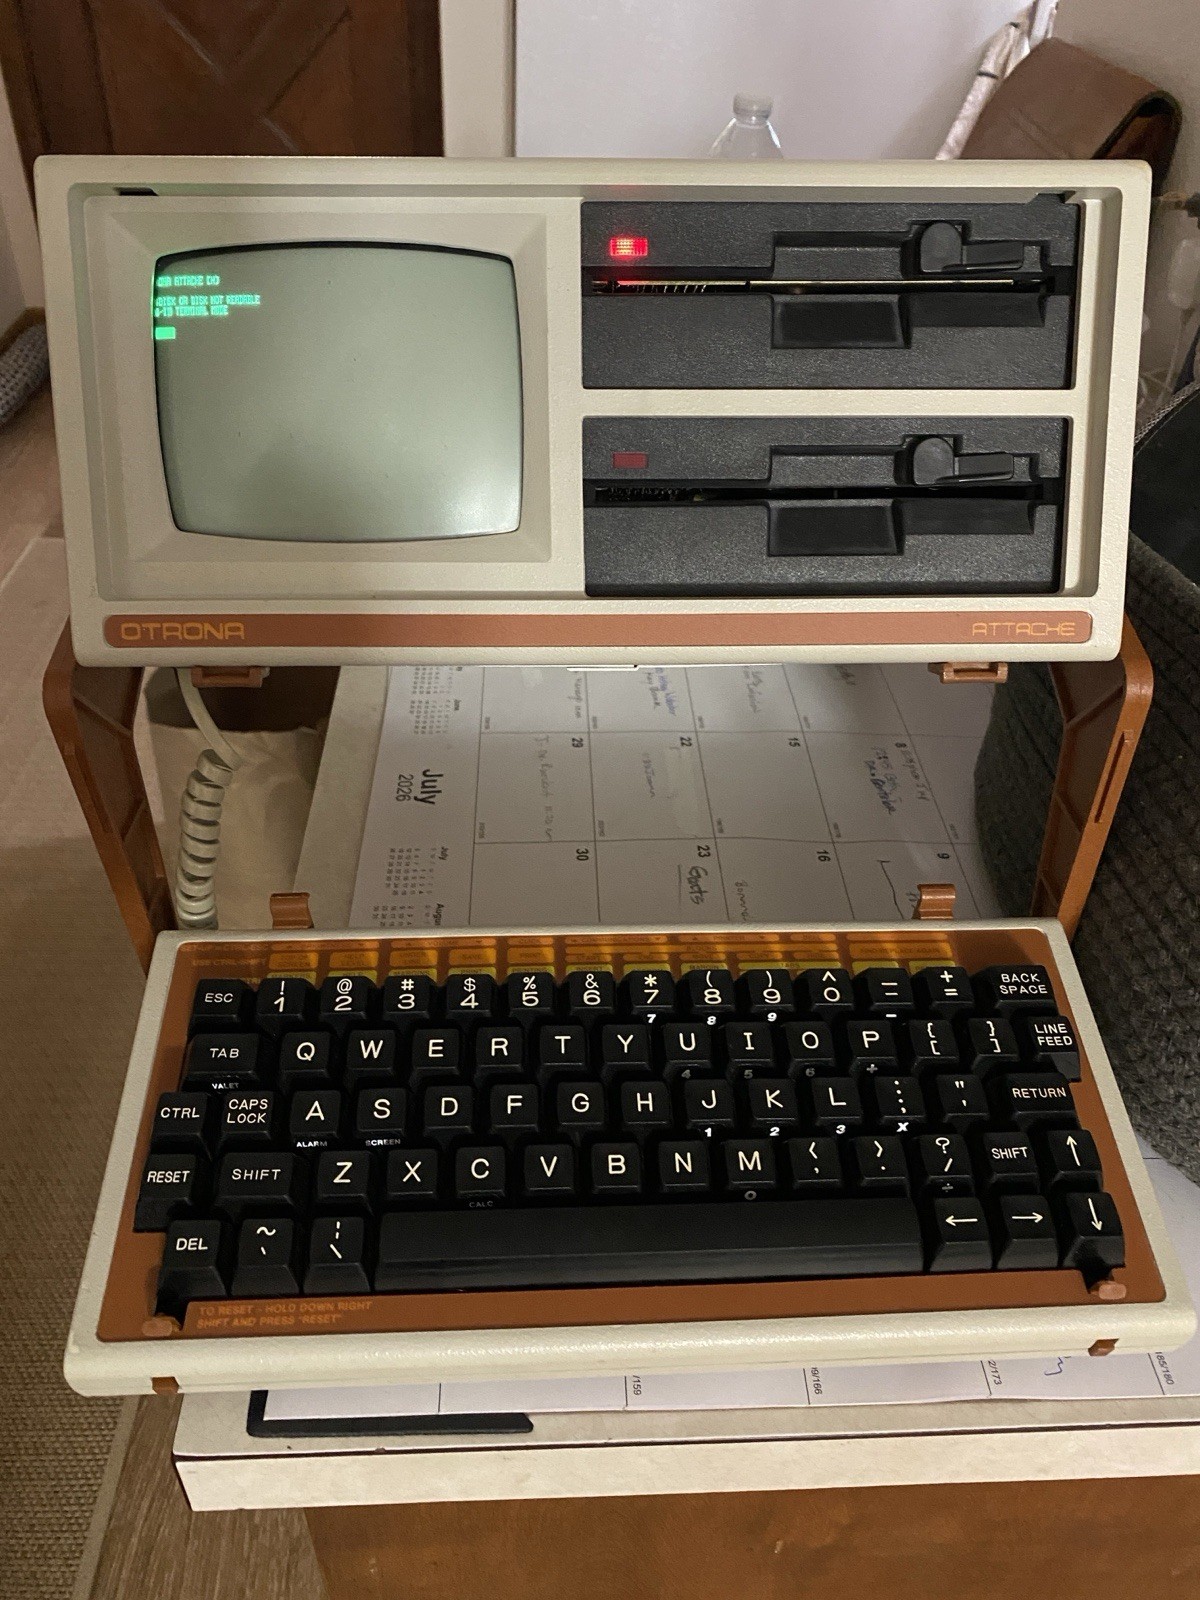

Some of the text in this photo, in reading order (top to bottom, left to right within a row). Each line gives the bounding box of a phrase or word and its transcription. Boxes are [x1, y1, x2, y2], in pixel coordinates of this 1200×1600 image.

[226, 294, 261, 305] READABLE
[121, 622, 245, 641] OTRONA
[972, 622, 1076, 637] ATTACHE
[571, 737, 584, 748] 29
[680, 736, 692, 747] 22
[788, 737, 801, 748] 15
[395, 773, 414, 802] 2026
[414, 768, 444, 805] July
[576, 848, 589, 861] 30
[697, 845, 711, 858] 23
[816, 850, 831, 862] 16
[337, 978, 352, 994] @
[401, 979, 414, 991] #
[463, 977, 476, 992] $
[523, 975, 536, 990] %
[584, 973, 601, 989] &
[1001, 973, 1040, 984] BACK
[280, 981, 285, 995] !
[763, 988, 781, 1004] 9
[999, 985, 1049, 995] SPACE
[205, 992, 234, 1003] ESC
[274, 997, 284, 1012] 1
[334, 995, 352, 1011] 2
[397, 993, 415, 1009] 3
[460, 993, 479, 1009] 4
[522, 991, 539, 1006] 5
[584, 989, 601, 1005] 6
[644, 989, 659, 1004] 7
[704, 989, 722, 1004] 8
[647, 1014, 656, 1023] 7
[707, 1016, 716, 1025] 8
[767, 1012, 777, 1022] 9
[1034, 1023, 1068, 1035] LINE
[491, 1038, 508, 1056] R
[555, 1036, 571, 1054] T
[617, 1034, 634, 1053] Y
[679, 1033, 696, 1051] U
[743, 1032, 755, 1050] I
[802, 1031, 819, 1049] O
[862, 1031, 880, 1048] P
[1037, 1035, 1073, 1046] FEED
[210, 1048, 239, 1058] TAB
[296, 1042, 315, 1061] Q
[360, 1040, 383, 1059] W
[428, 1039, 444, 1057] E
[702, 1090, 716, 1109] J
[766, 1089, 783, 1108] K
[828, 1087, 846, 1106] L
[1012, 1087, 1066, 1099] RETURN
[229, 1099, 268, 1110] CAPS
[373, 1099, 390, 1119] S
[441, 1097, 458, 1116] D
[507, 1095, 523, 1114] F
[571, 1093, 589, 1112] G
[637, 1092, 653, 1112] H
[161, 1107, 200, 1119] CTRL
[227, 1113, 266, 1123] LOCK
[305, 1100, 324, 1121] A
[704, 1127, 712, 1137] 1
[769, 1127, 780, 1136] 2
[836, 1124, 846, 1134] 3
[935, 1137, 950, 1154] ?
[991, 1147, 1027, 1159] SHIFT
[471, 1158, 489, 1179] C
[540, 1156, 558, 1177] V
[608, 1154, 626, 1174] B
[675, 1152, 692, 1173] N
[738, 1151, 761, 1171] M
[147, 1170, 190, 1183] RESET
[232, 1168, 281, 1180] SHIFT
[333, 1162, 353, 1183] Z
[403, 1161, 421, 1182] X
[176, 1238, 208, 1251] DEL
[200, 1305, 215, 1315] TO
[218, 1305, 252, 1315] RESET
[265, 1303, 296, 1314] HOLD
[300, 1302, 334, 1313] DOWN
[337, 1301, 372, 1311] RIGHT
[197, 1318, 228, 1329] SHIFT
[233, 1317, 256, 1327] AND
[259, 1316, 295, 1326] PRESS
[987, 1359, 1003, 1386] 2/173
[1155, 1352, 1175, 1385] 185/180
[632, 1374, 642, 1396] /159
